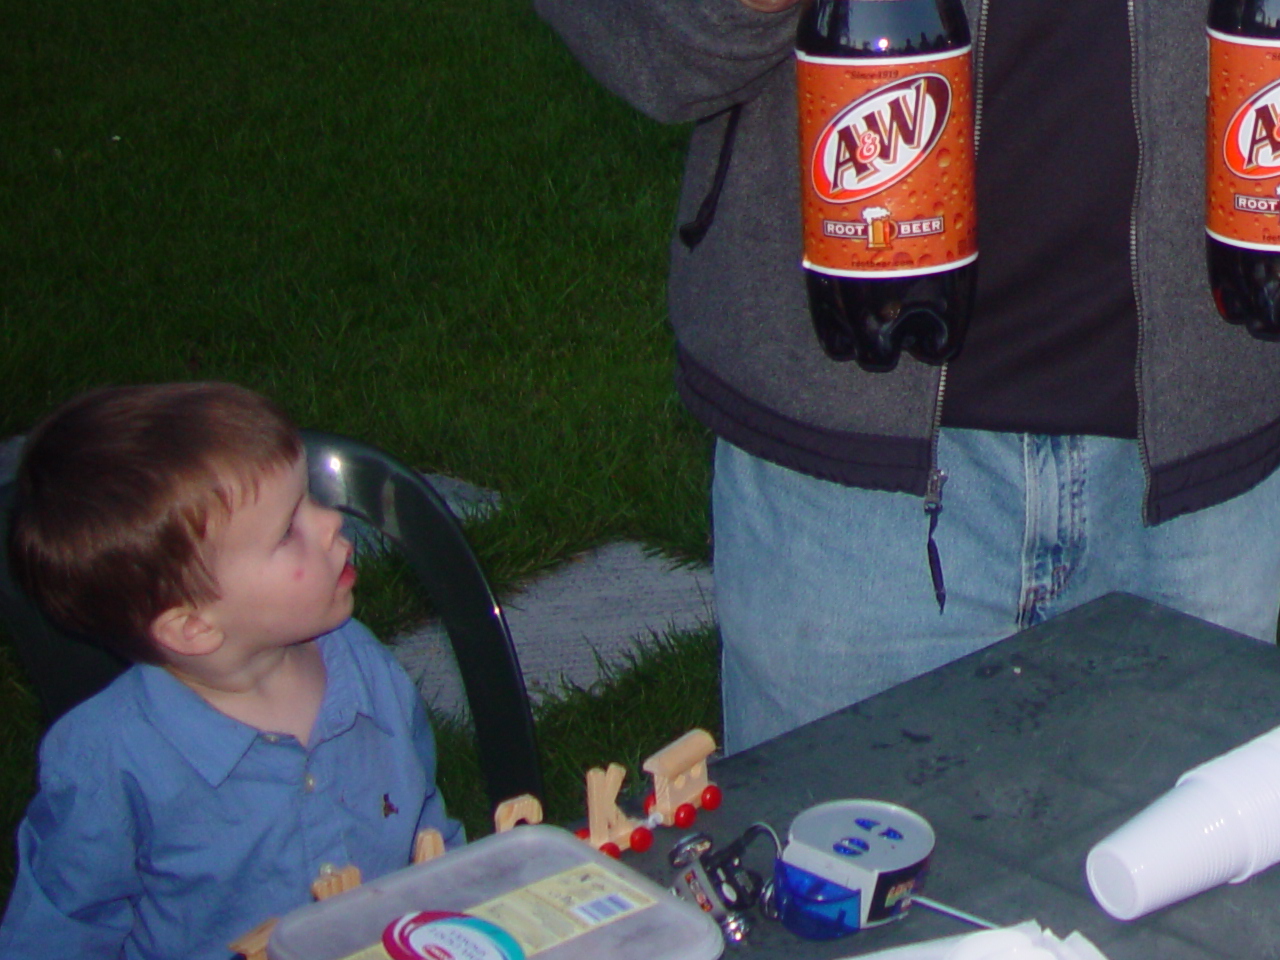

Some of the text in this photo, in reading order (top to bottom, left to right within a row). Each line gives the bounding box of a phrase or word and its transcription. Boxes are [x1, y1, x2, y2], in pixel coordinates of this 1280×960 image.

[879, 70, 899, 79] 1919
[829, 79, 928, 194] A&W
[1238, 198, 1277, 211] ROOT
[826, 220, 941, 237] ROOT BEER
